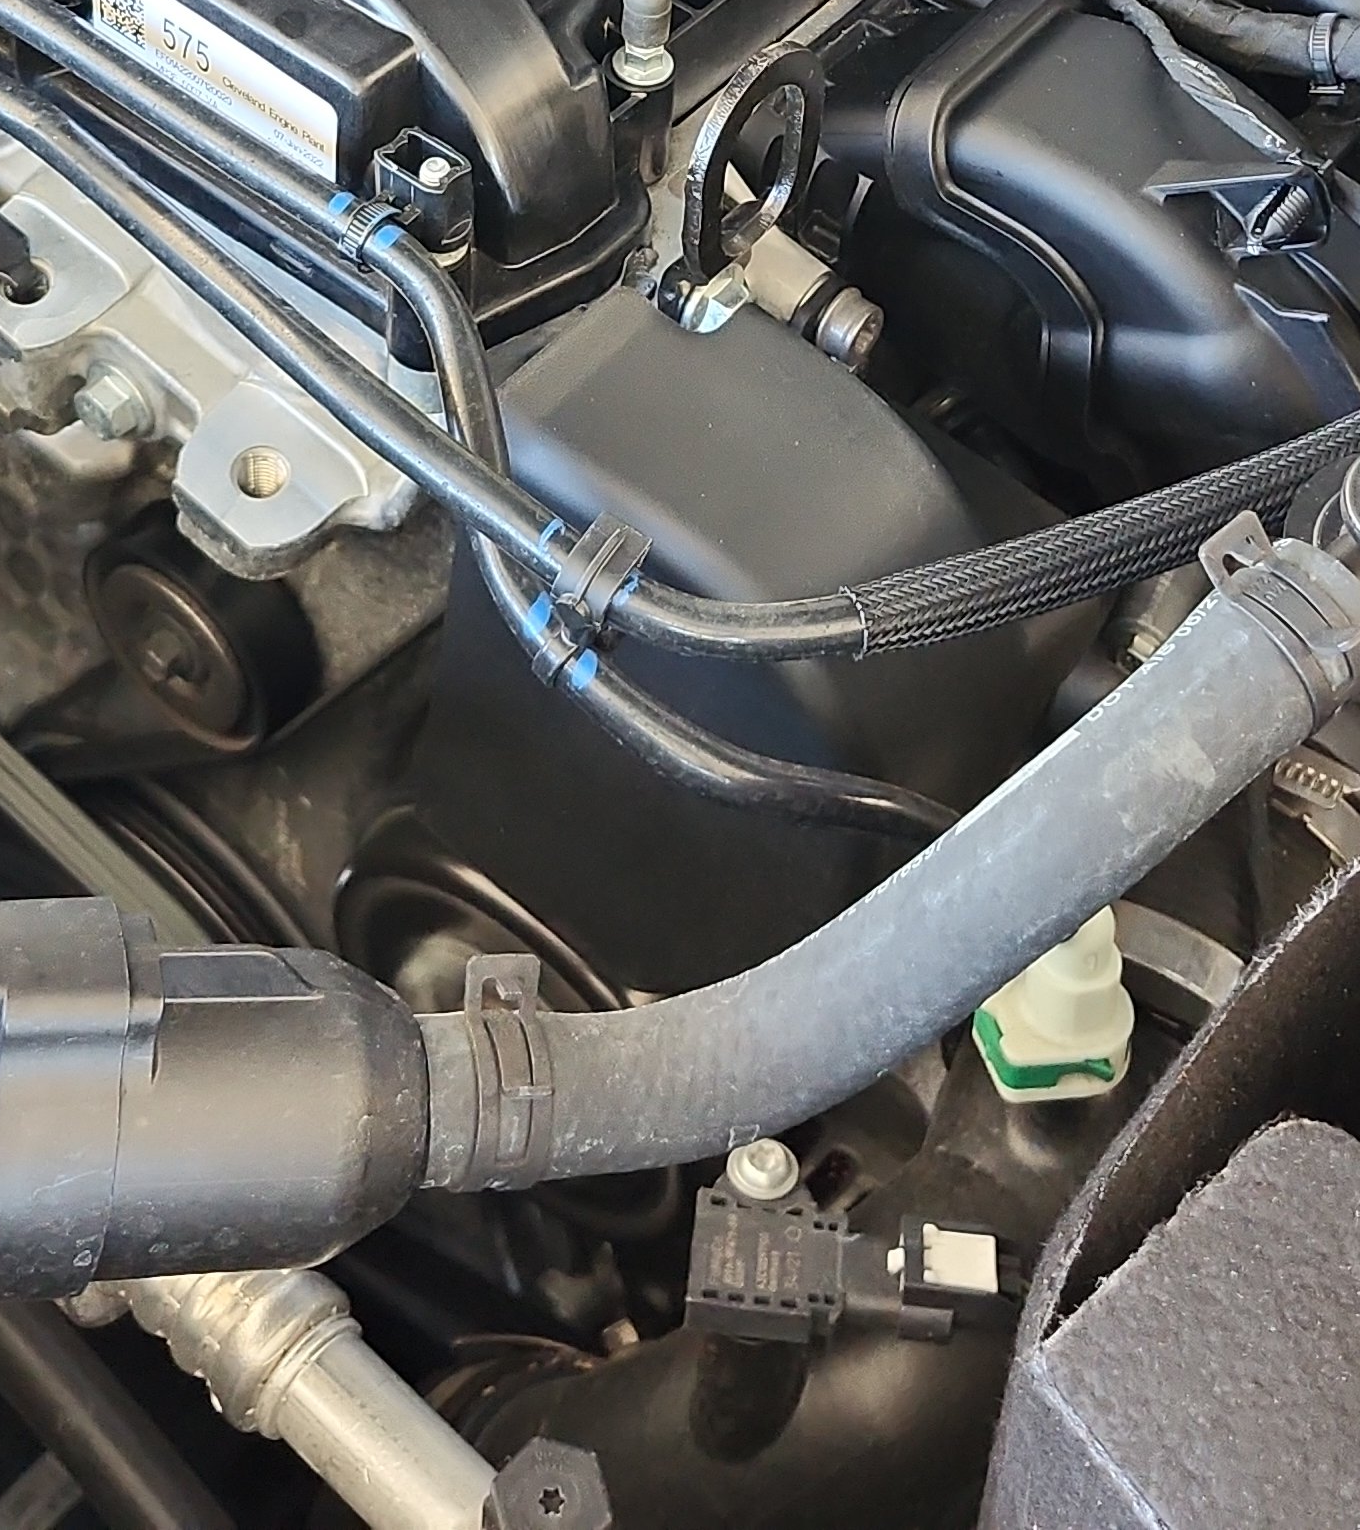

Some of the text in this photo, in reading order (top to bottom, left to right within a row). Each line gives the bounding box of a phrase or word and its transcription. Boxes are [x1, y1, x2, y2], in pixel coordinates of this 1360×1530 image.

[162, 17, 210, 73] 575
[221, 75, 267, 113] Cleveland
[268, 109, 299, 136] Engine
[302, 129, 326, 153] Plant
